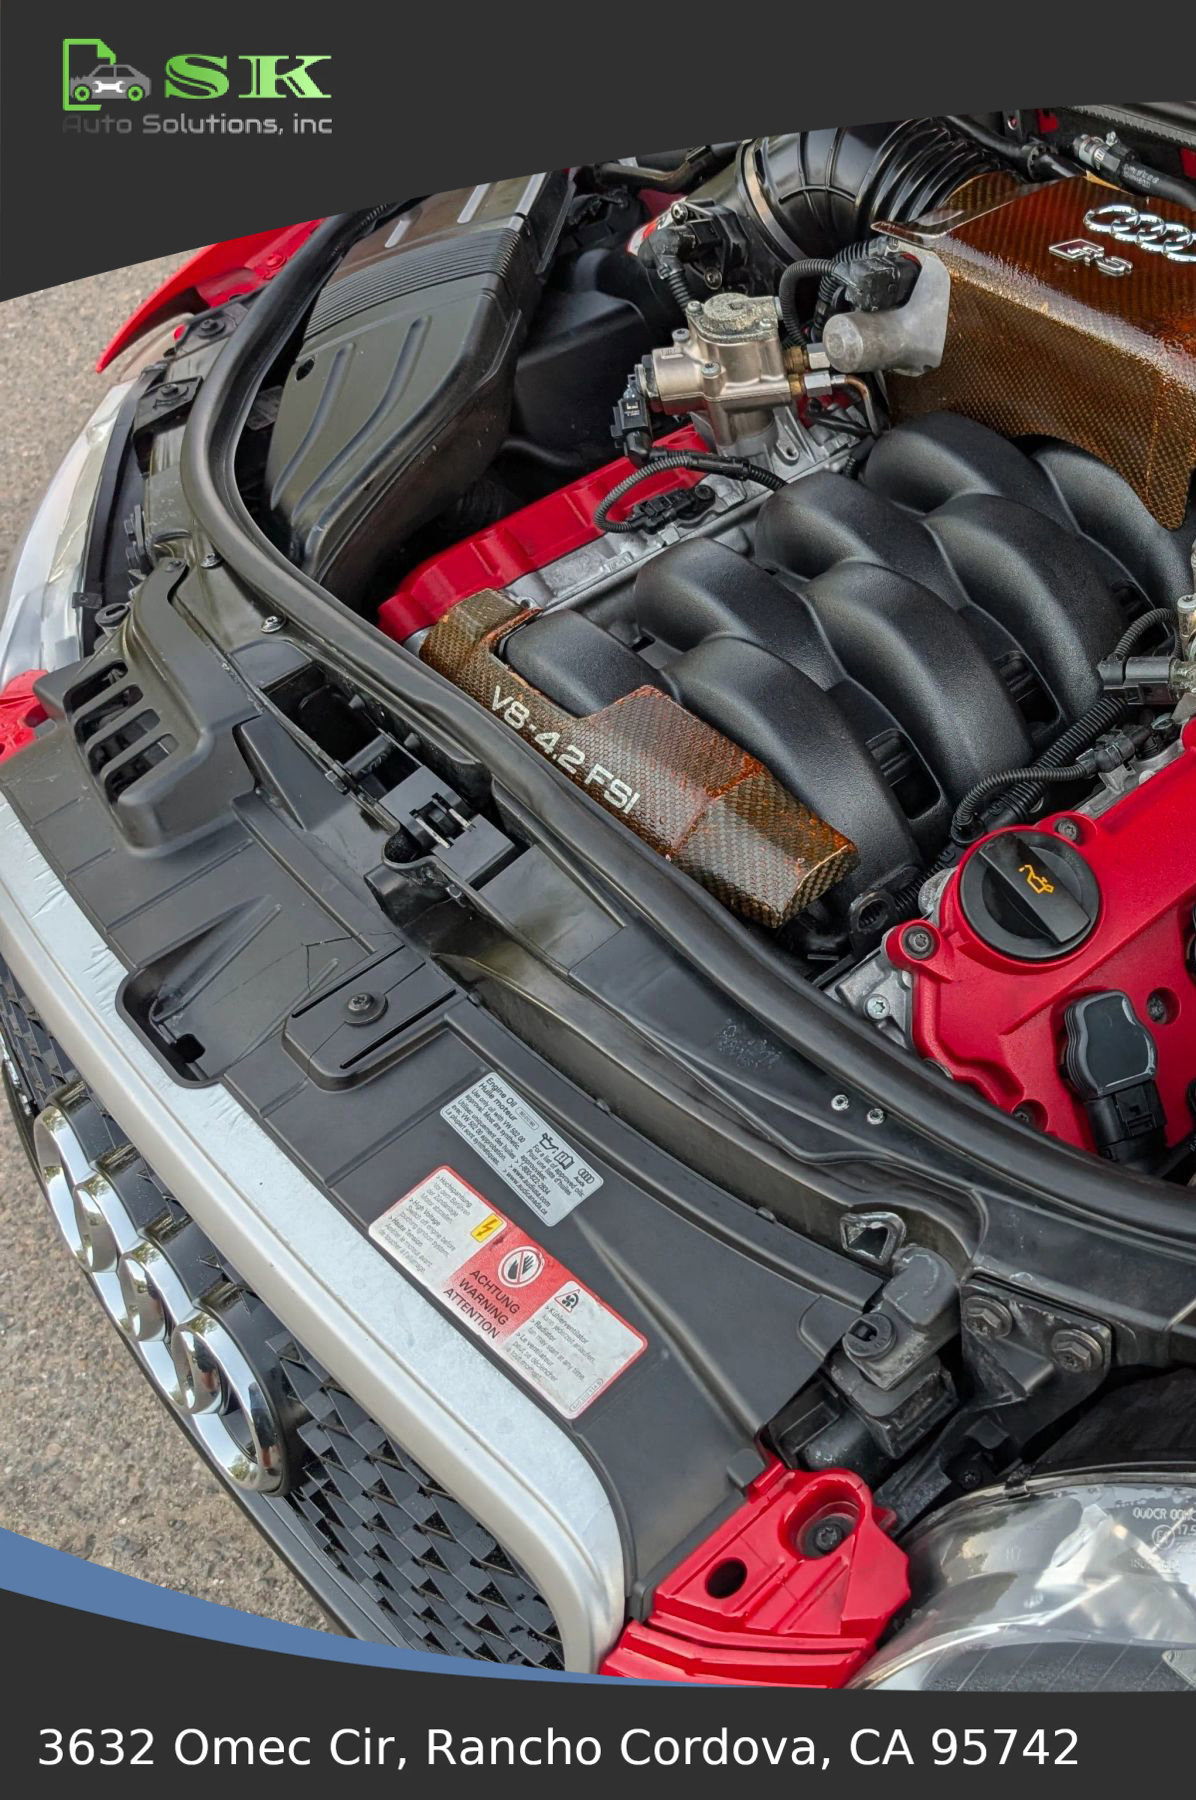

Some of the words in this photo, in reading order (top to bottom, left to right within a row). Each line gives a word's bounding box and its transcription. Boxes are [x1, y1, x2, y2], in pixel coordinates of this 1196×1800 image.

[584, 763, 640, 814] FSI
[479, 1083, 496, 1099] Huile
[493, 1098, 518, 1122] moteur
[485, 1077, 508, 1099] Engine
[506, 1097, 518, 1108] Oil
[461, 1113, 471, 1122] VW
[471, 1089, 482, 1099] Use
[488, 1105, 496, 1113] oil
[493, 1111, 505, 1122] with
[503, 1120, 513, 1130] VW
[517, 1135, 526, 1143] 00
[494, 1137, 505, 1146] des
[526, 1149, 540, 1161] Pour
[537, 1160, 546, 1170] une
[532, 1144, 543, 1154] For
[543, 1155, 553, 1164] list
[554, 1167, 577, 1190] approved
[411, 1200, 425, 1212] High
[421, 1209, 442, 1227] Voltage
[392, 1218, 407, 1231] Haute
[405, 1229, 424, 1247] Tension
[457, 1278, 510, 1326] WARNING
[469, 1268, 521, 1315] ACHTUNG
[443, 1286, 500, 1339] ATTENTION
[534, 1321, 558, 1342] Radiator
[520, 1334, 529, 1343] Le
[526, 1341, 555, 1367] ventilateur
[534, 1335, 548, 1347] may
[546, 1344, 560, 1357] start
[562, 1359, 573, 1370] any
